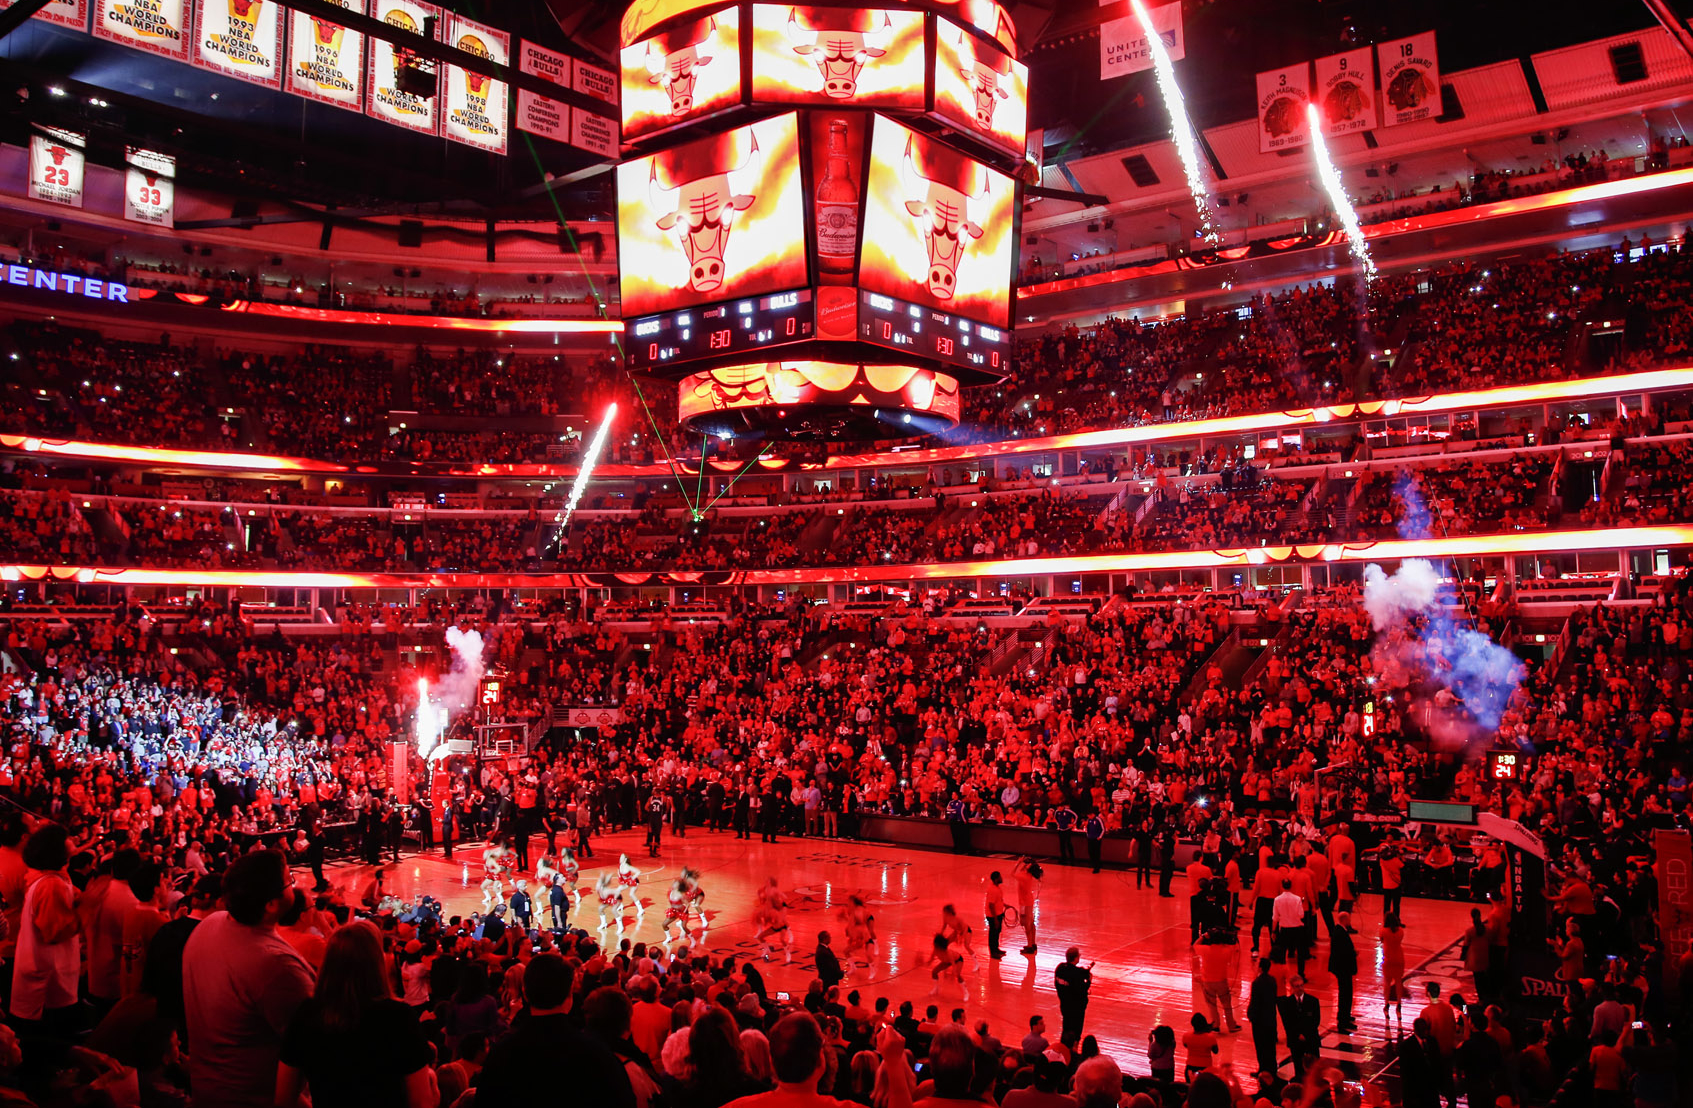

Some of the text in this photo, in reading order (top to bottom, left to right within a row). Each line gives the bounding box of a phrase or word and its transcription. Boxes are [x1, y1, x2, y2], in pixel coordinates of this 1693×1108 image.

[134, 0, 158, 12] NBA
[124, 5, 167, 25] WORLD
[108, 11, 180, 40] CHAMPIONS
[228, 16, 254, 32] 1993
[228, 27, 251, 41] NBA
[219, 34, 259, 53] WORLD
[314, 44, 339, 58] 1996
[459, 41, 496, 61] CHICAGO
[1106, 38, 1147, 55] UNITE
[1400, 43, 1413, 58] 18
[205, 40, 271, 68] CHAMPIONS
[316, 54, 336, 67] NBA
[527, 48, 564, 68] CHICAGO
[1107, 48, 1148, 65] CENTE
[308, 61, 344, 78] WORLD
[533, 60, 559, 75] BULLS
[1339, 57, 1347, 71] 9
[1386, 57, 1433, 78] DENIS SAVARD
[296, 68, 355, 92] CHAMPIONS
[580, 67, 614, 86] CHICAGO
[1279, 74, 1287, 86] 3
[1326, 70, 1365, 88] BOBBY HULL
[585, 78, 610, 93] BULLS
[376, 93, 429, 116] CHAMPIONS
[386, 88, 419, 104] WORLD
[465, 93, 487, 106] 1998
[533, 98, 556, 111] EASTERN
[1261, 91, 1276, 110] KEITH
[460, 109, 490, 123] WORLD
[466, 103, 484, 113] NBA
[528, 105, 560, 120] CONFERENCE
[450, 115, 500, 136] CHAMPIONS
[528, 113, 560, 128] CHAMPIONS
[586, 115, 606, 128] EASTERN
[581, 122, 611, 137] CONFERENCE
[581, 130, 611, 144] CHAMPIONS
[45, 166, 69, 187] 23
[31, 180, 81, 195] MICHAEL JORDAN
[140, 187, 160, 206] 33
[819, 227, 856, 239] Budweiser
[0, 263, 128, 303] ENTER
[769, 292, 798, 310] BULLS
[821, 301, 857, 317] Budweiser
[785, 317, 796, 336] 0
[883, 321, 892, 340] 0
[709, 329, 731, 349] 1:30
[936, 336, 954, 356] 1:30
[649, 343, 659, 360] 0
[991, 351, 999, 368] 0
[1571, 450, 1608, 460] 201 202
[483, 690, 497, 704] 24
[1364, 715, 1374, 736] 24
[1498, 754, 1516, 765] 1:30
[1495, 764, 1511, 778] 24
[1514, 824, 1539, 846] SPALDING
[1514, 866, 1523, 913] NBA TV
[1666, 858, 1688, 905] RED
[735, 940, 871, 970] UNITD
